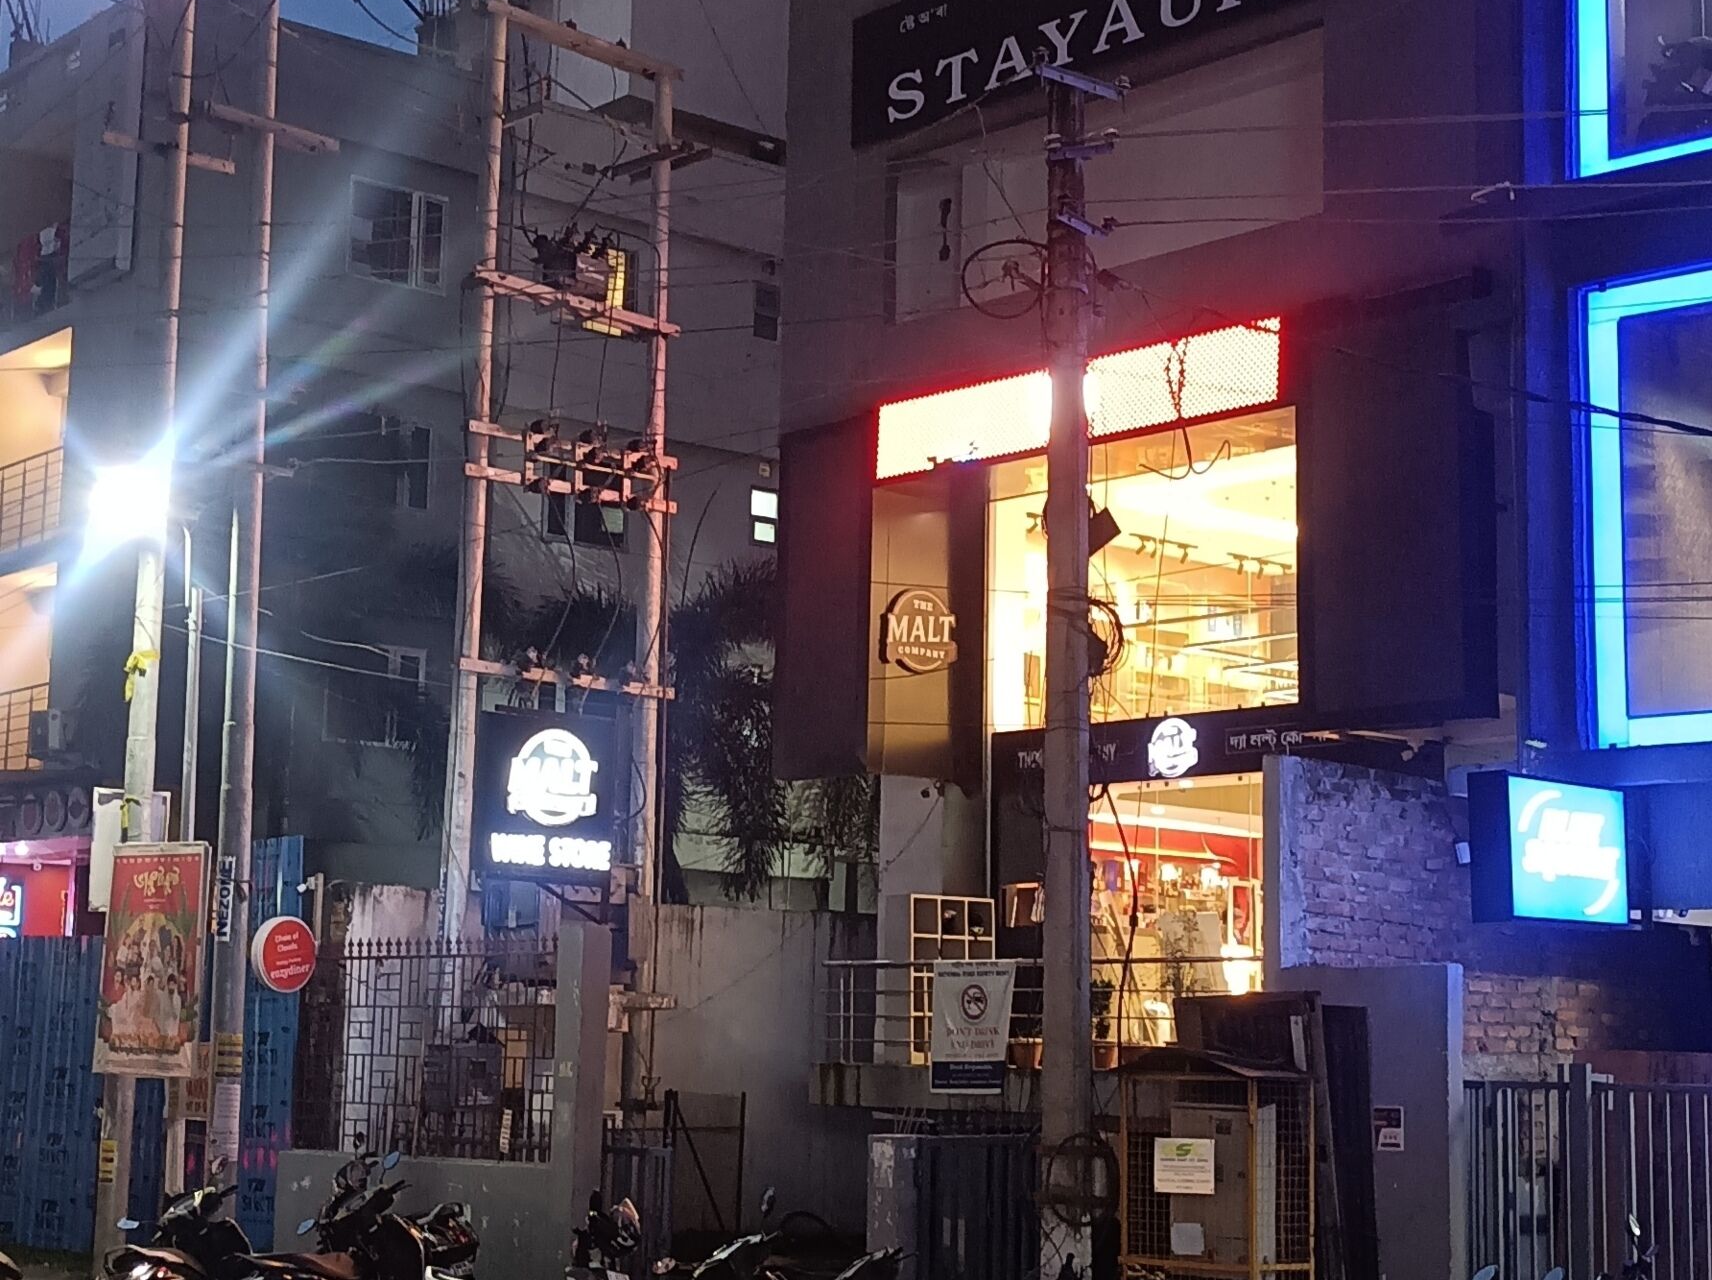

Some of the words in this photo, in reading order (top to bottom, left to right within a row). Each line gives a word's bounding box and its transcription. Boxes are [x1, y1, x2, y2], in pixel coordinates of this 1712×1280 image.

[912, 599, 934, 612] THE
[887, 613, 957, 644] MALT
[897, 645, 946, 660] COMPANY
